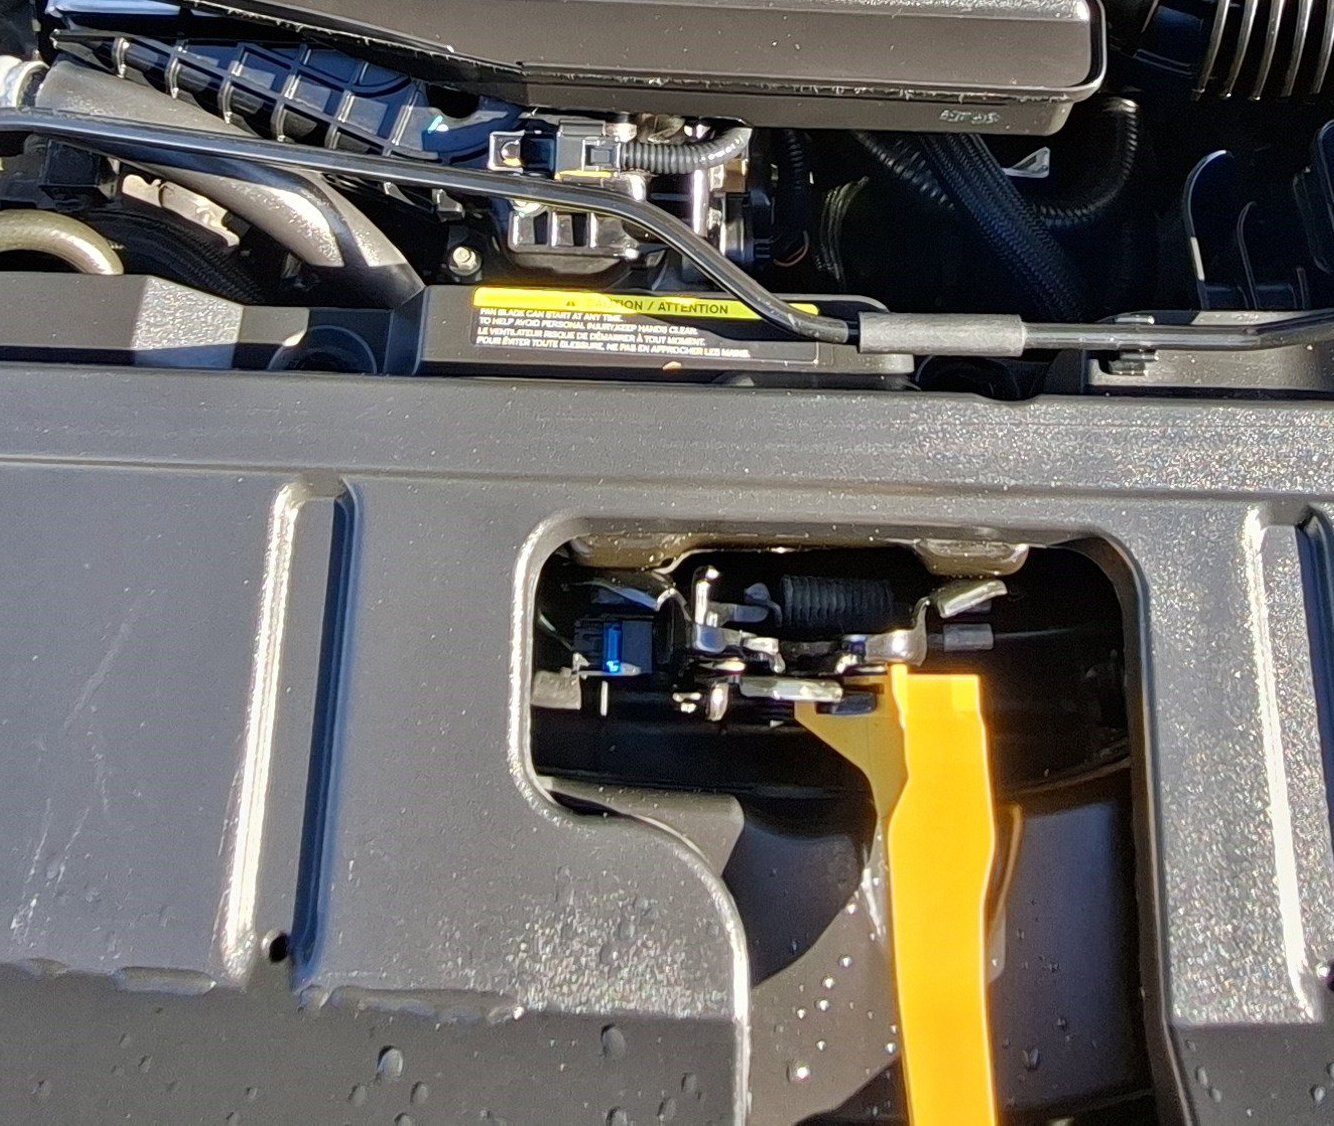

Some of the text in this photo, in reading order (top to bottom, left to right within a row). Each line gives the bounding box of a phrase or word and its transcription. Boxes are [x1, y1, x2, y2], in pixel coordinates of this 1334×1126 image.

[658, 302, 729, 314] ATTENTION
[526, 310, 545, 318] CAN
[572, 312, 583, 320] AT
[584, 313, 601, 321] ANY
[479, 317, 491, 325] TO
[492, 317, 514, 325] HELP
[515, 319, 540, 327] AVOID
[542, 320, 585, 329] PERSONAL
[477, 327, 488, 335] LE
[489, 327, 542, 337] VENTILATEUR
[544, 330, 575, 339] RISQUE
[576, 332, 588, 340] DE
[644, 335, 666, 344] TOUT
[476, 336, 501, 345] POUR
[532, 339, 559, 348] TOUTE
[607, 343, 618, 351] NE
[620, 343, 636, 352] PAS
[638, 344, 649, 353] EN
[651, 345, 703, 355] APPROCHER
[704, 348, 720, 356] LES
